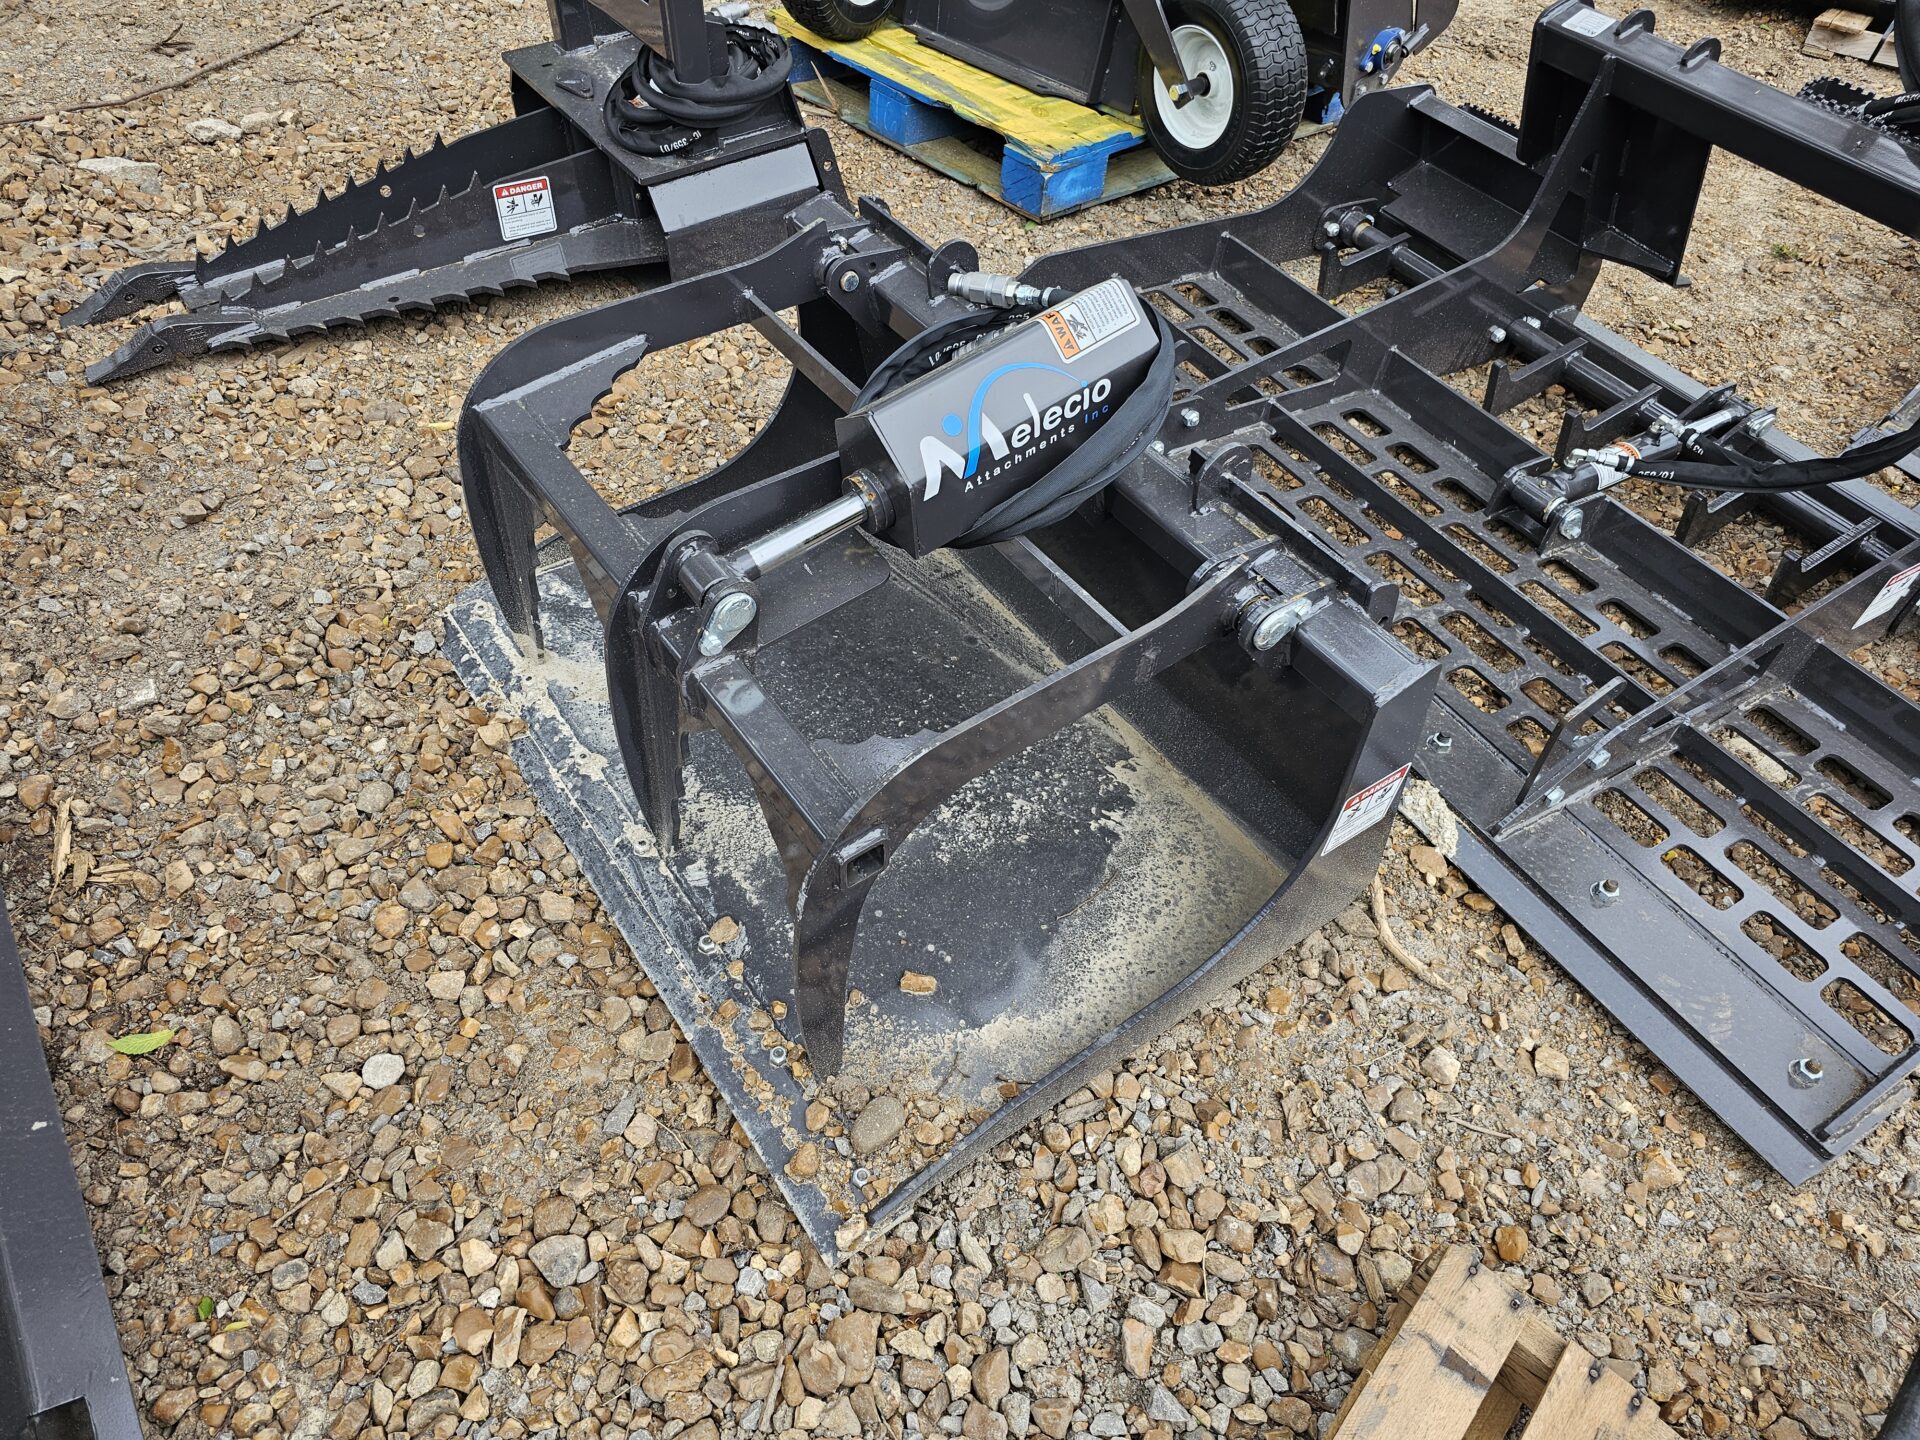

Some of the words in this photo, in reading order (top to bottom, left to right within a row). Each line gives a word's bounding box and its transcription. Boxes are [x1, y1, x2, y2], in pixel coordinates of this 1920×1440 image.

[510, 182, 543, 195] DANGER
[920, 378, 1112, 502] Melecio
[964, 423, 1075, 493] Attachments
[1084, 404, 1109, 424] Inc
[1360, 771, 1402, 801] DANGER
